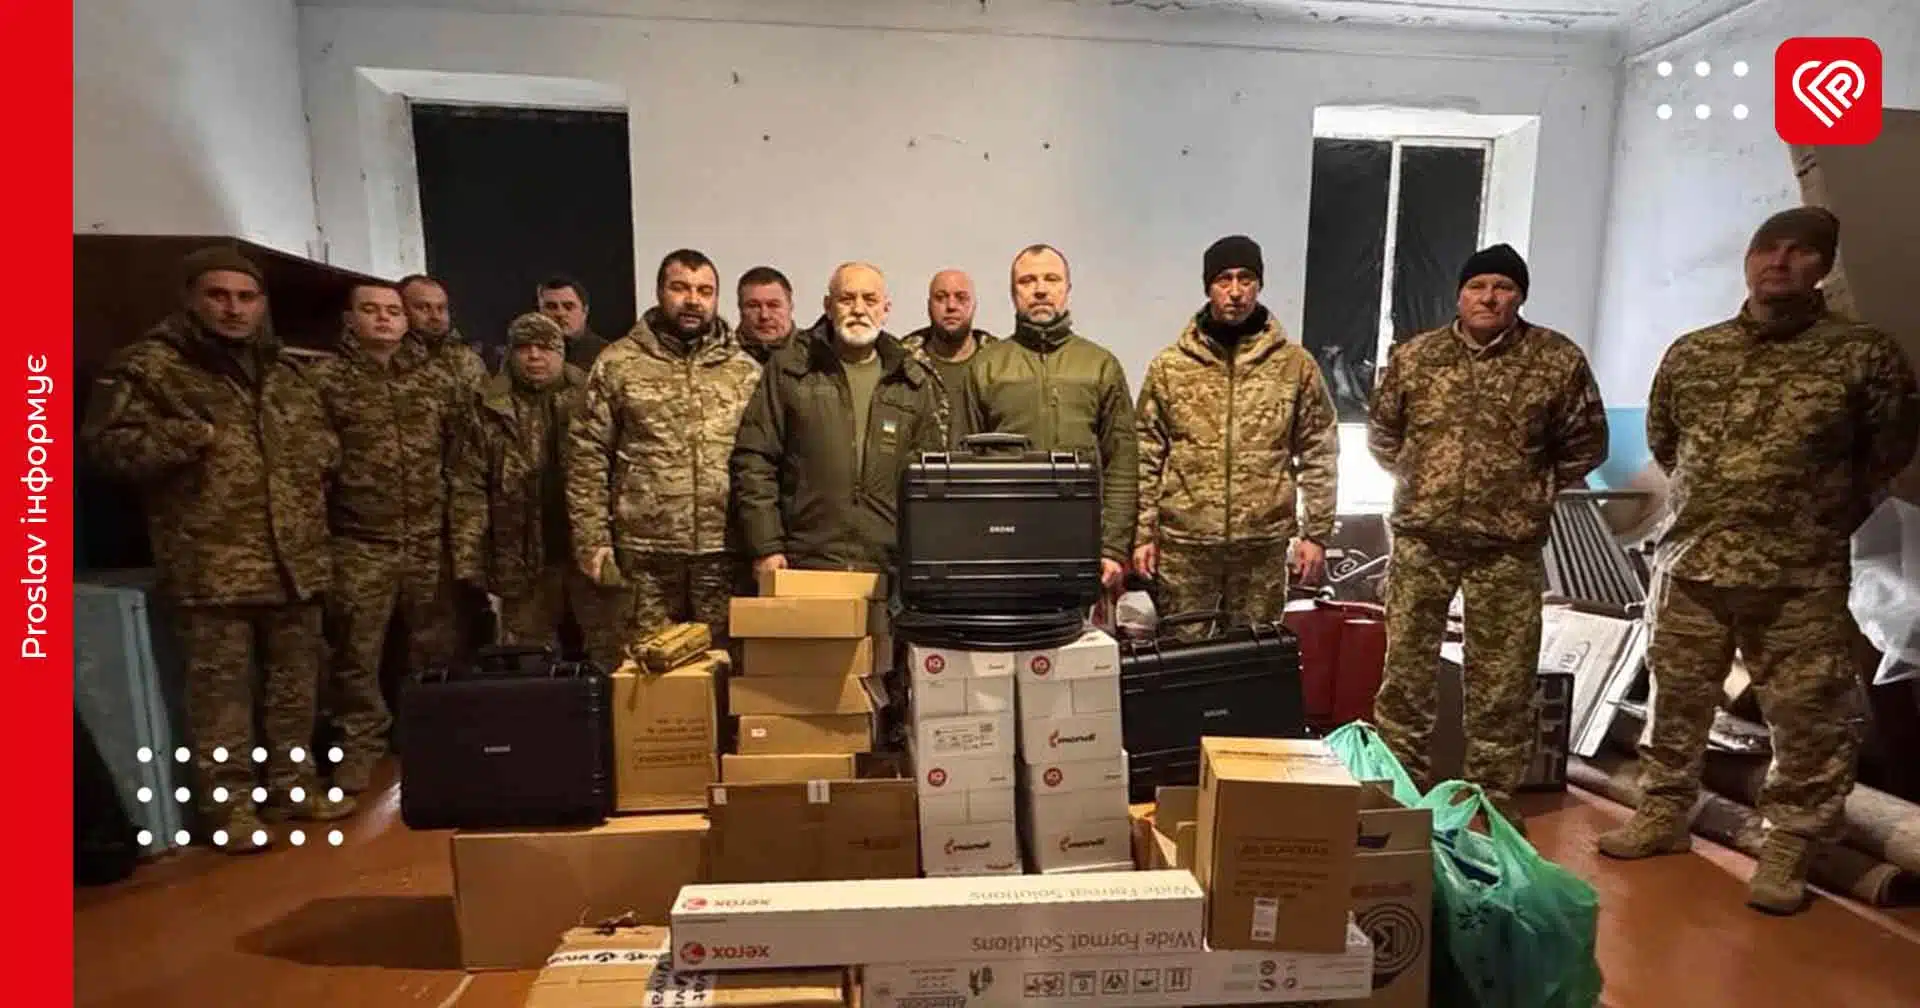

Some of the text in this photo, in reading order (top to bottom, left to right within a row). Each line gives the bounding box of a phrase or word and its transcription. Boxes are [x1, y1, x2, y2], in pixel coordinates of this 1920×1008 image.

[972, 929, 1196, 952] Wide Format Solutions
[711, 945, 770, 960] xerox
